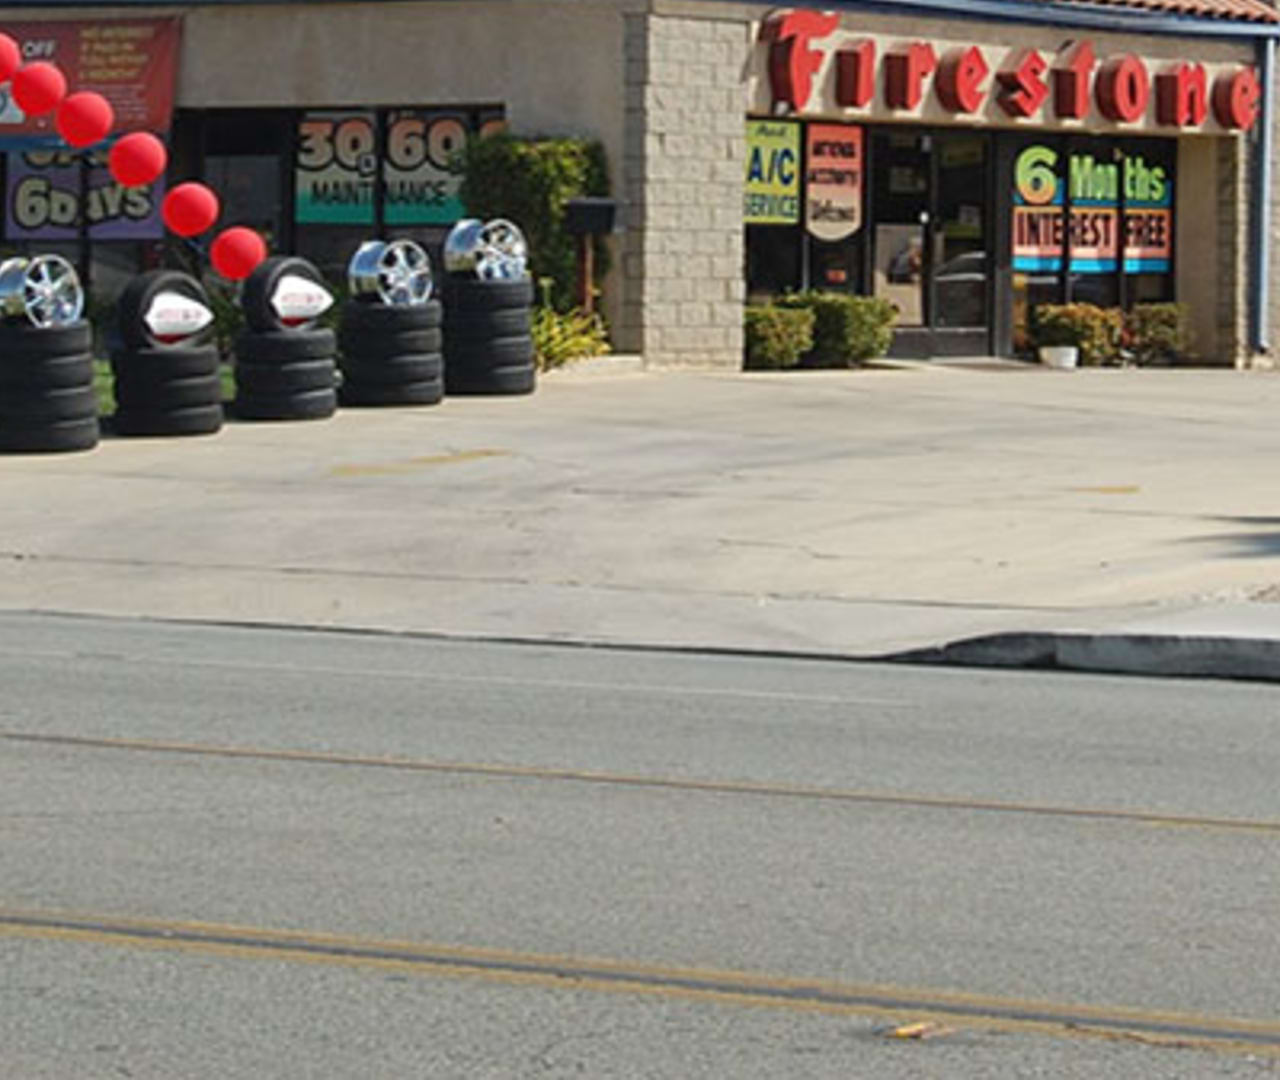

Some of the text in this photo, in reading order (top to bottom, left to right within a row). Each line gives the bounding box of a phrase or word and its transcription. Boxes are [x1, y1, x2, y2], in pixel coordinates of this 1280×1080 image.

[22, 40, 56, 58] OFF
[761, 8, 1262, 131] Firestone
[747, 146, 795, 186] A/C
[1015, 145, 1166, 205] 6 Months
[312, 180, 448, 206] MAINTNANCE
[1016, 212, 1166, 248] INTEREST FREE
